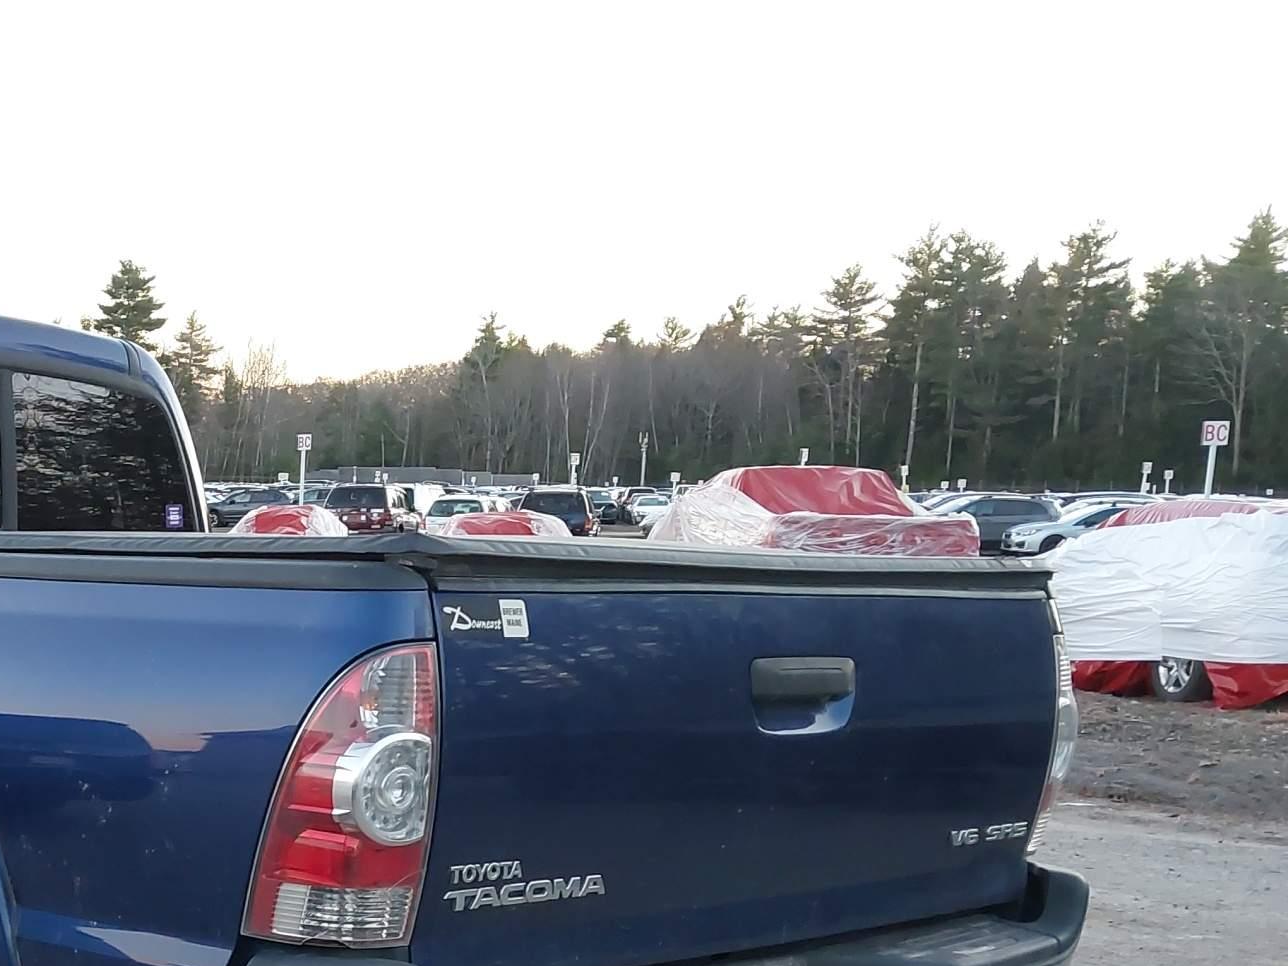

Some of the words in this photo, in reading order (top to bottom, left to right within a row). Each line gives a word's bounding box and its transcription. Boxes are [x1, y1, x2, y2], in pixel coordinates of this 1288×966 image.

[298, 436, 311, 448] BC
[1205, 424, 1228, 442] BC
[443, 606, 502, 631] Downeast
[951, 828, 979, 846] V6
[985, 821, 1028, 840] SR5
[450, 860, 523, 884] TOYOTA
[443, 874, 606, 912] TACOMA
